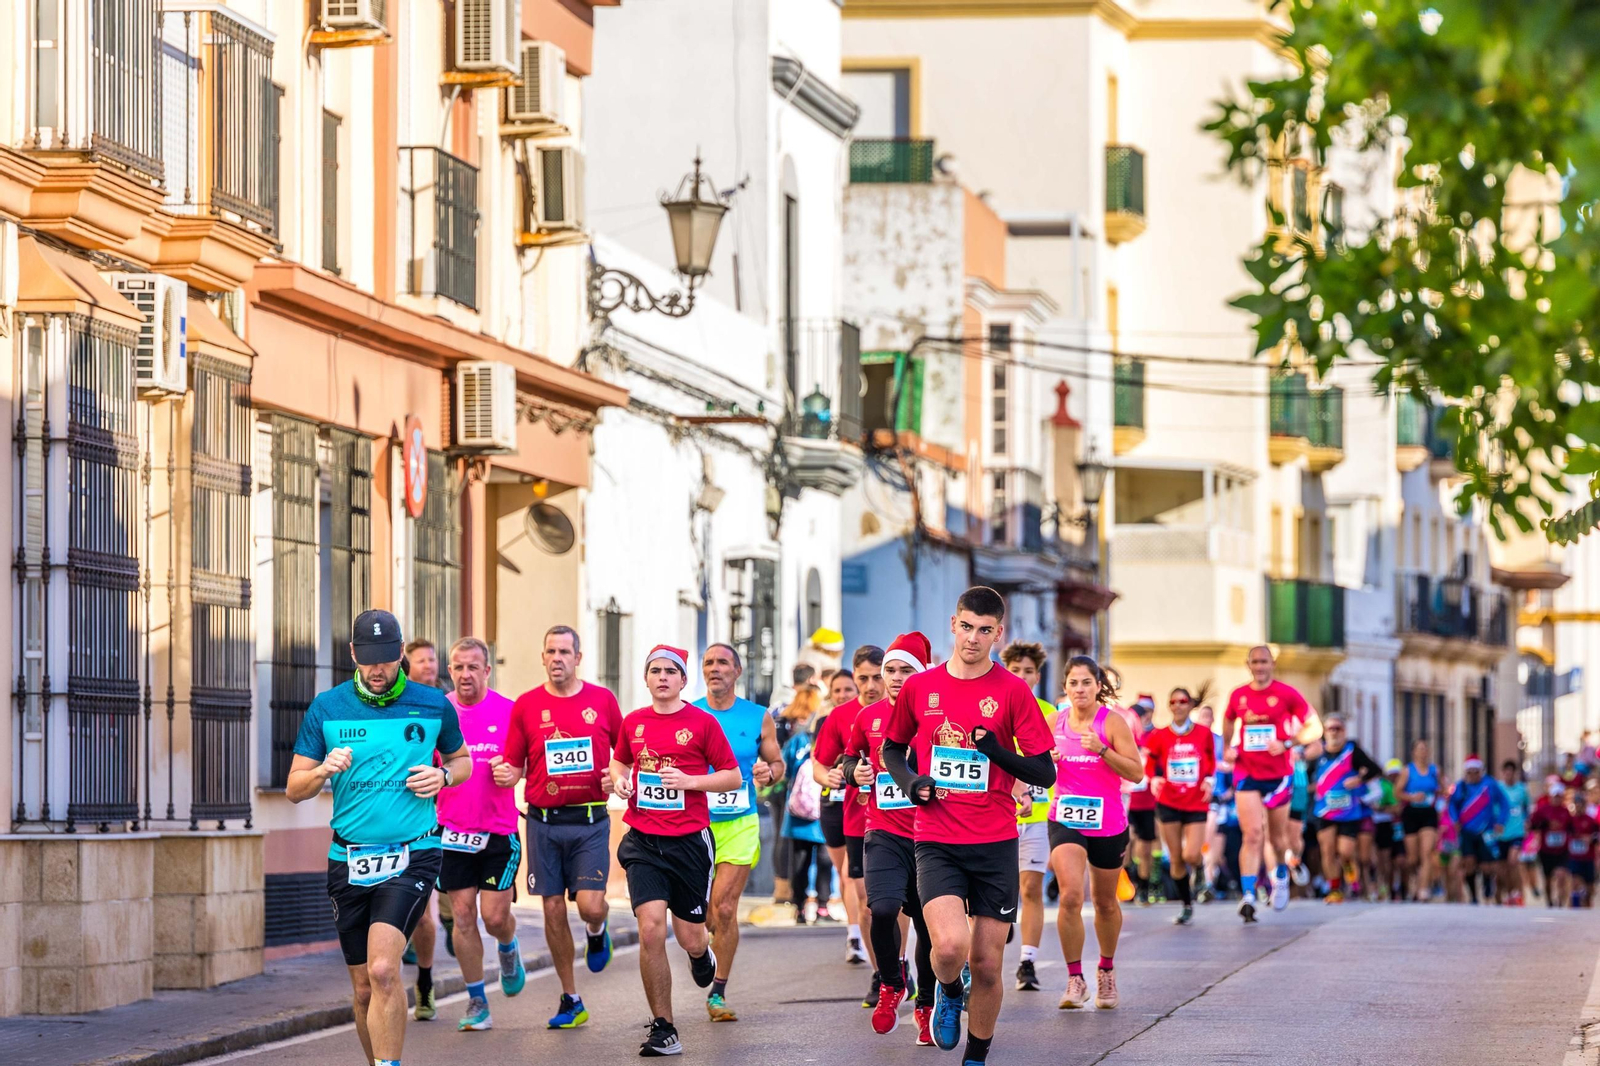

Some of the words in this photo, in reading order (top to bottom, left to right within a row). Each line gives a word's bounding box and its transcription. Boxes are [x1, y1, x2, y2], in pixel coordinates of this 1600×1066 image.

[553, 750, 587, 765] 340
[939, 761, 982, 780] 515
[350, 779, 407, 791] greenhom
[643, 786, 678, 800] 430
[717, 792, 738, 805] 37
[1063, 807, 1097, 821] 212
[449, 832, 482, 846] 318
[356, 854, 400, 875] 377
